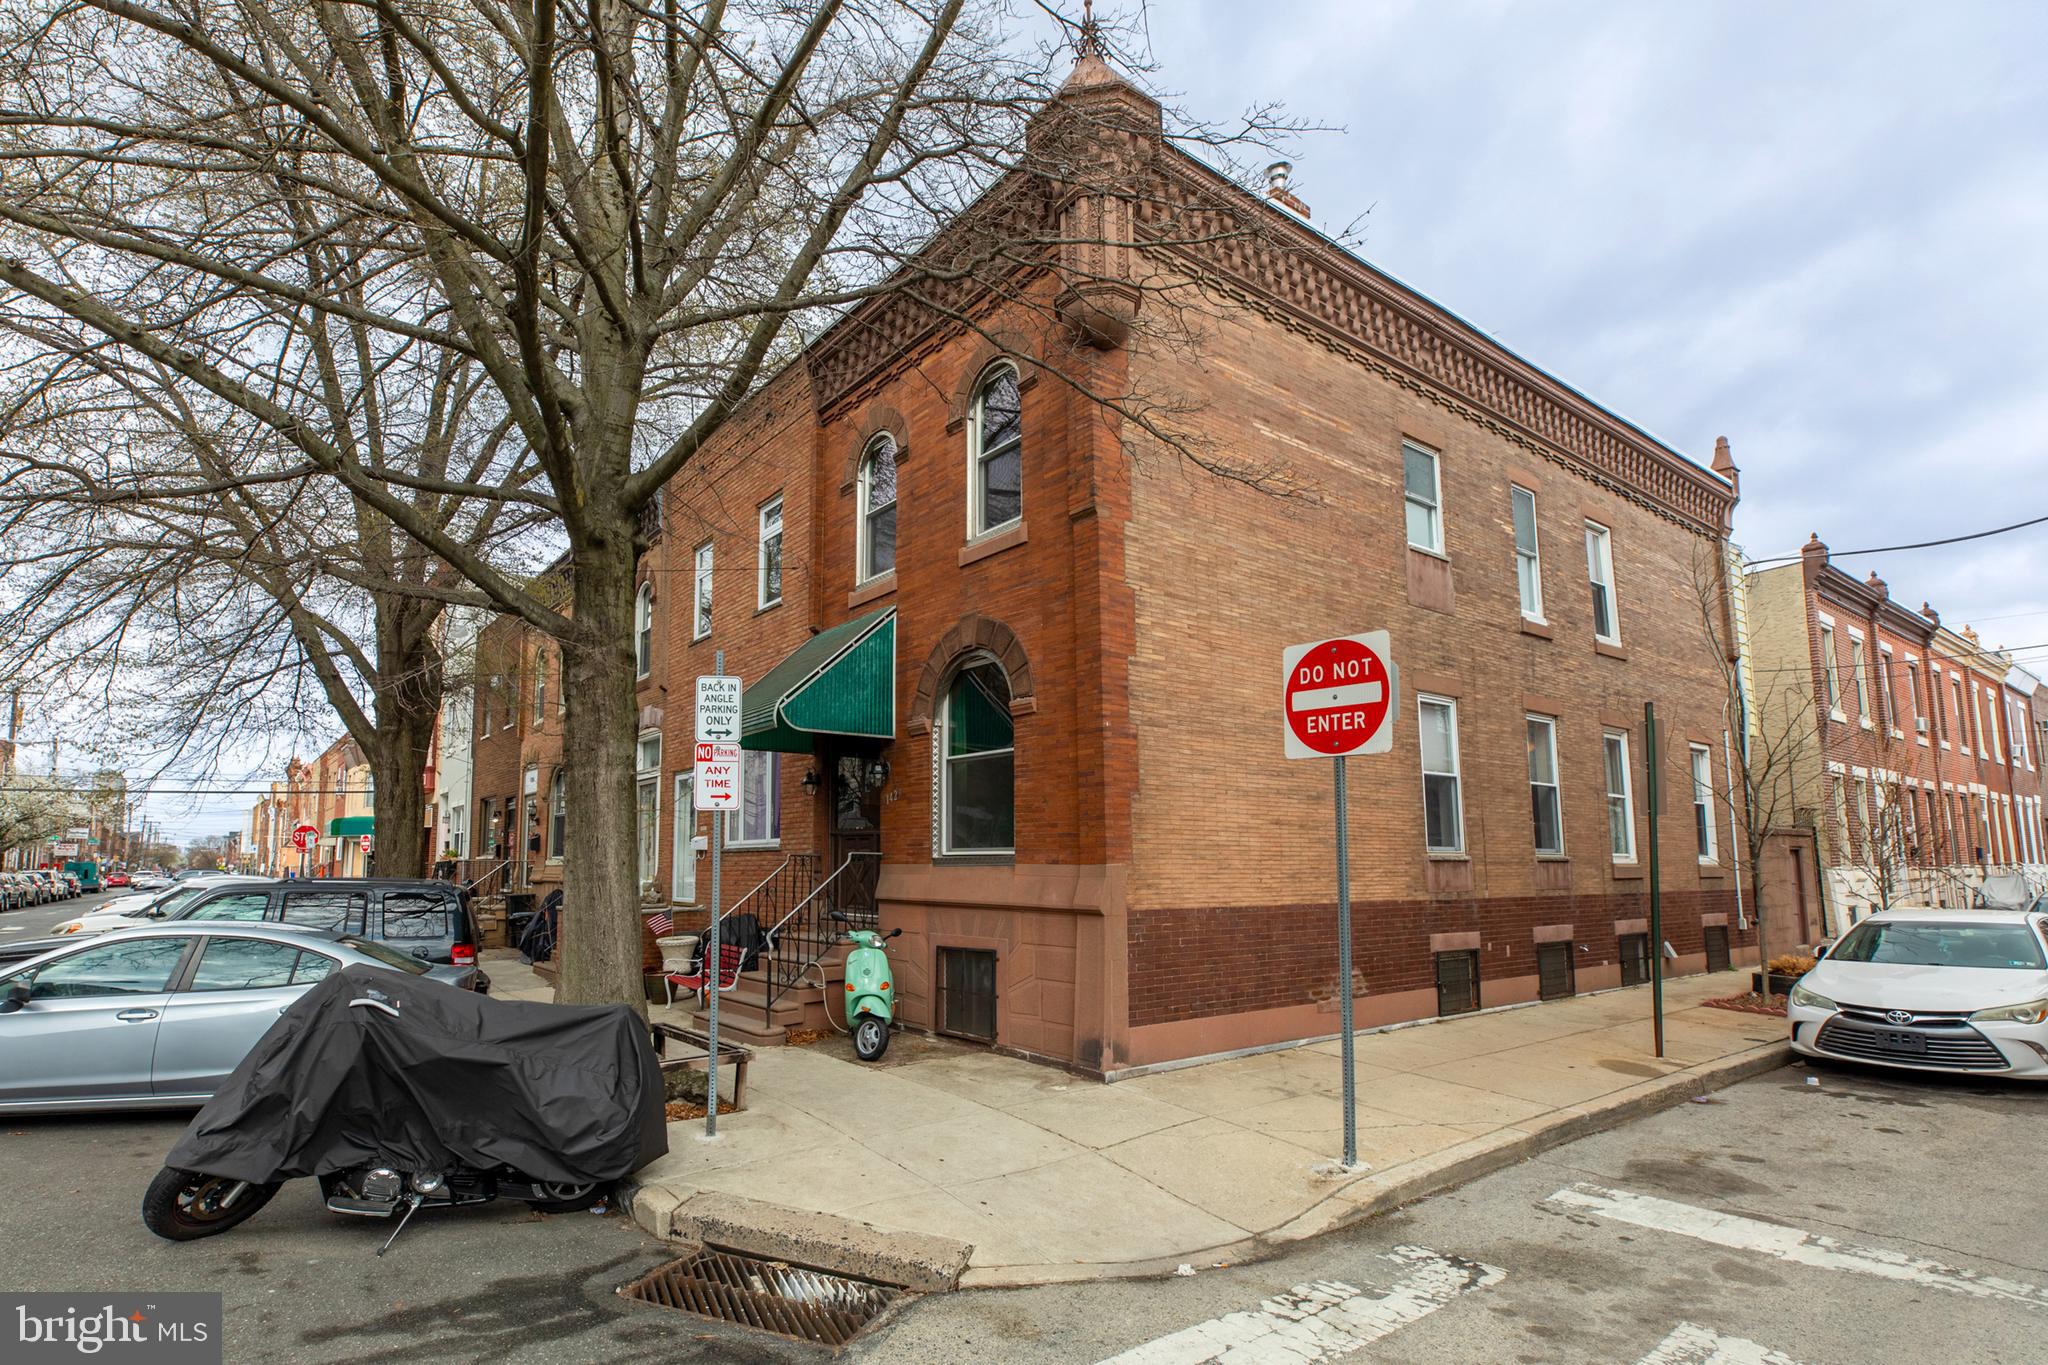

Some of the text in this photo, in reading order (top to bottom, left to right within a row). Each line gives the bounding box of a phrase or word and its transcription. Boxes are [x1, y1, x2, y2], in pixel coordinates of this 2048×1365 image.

[1300, 657, 1372, 685] DO NOT
[701, 683, 737, 692] BACK IN
[704, 694, 734, 703] ANGLE
[700, 705, 738, 714] PARKING
[706, 716, 732, 726] ONLY
[1307, 711, 1366, 734] ENTER
[698, 746, 737, 760] NO PARKING
[705, 766, 731, 775] ANY
[704, 779, 731, 788] TIME
